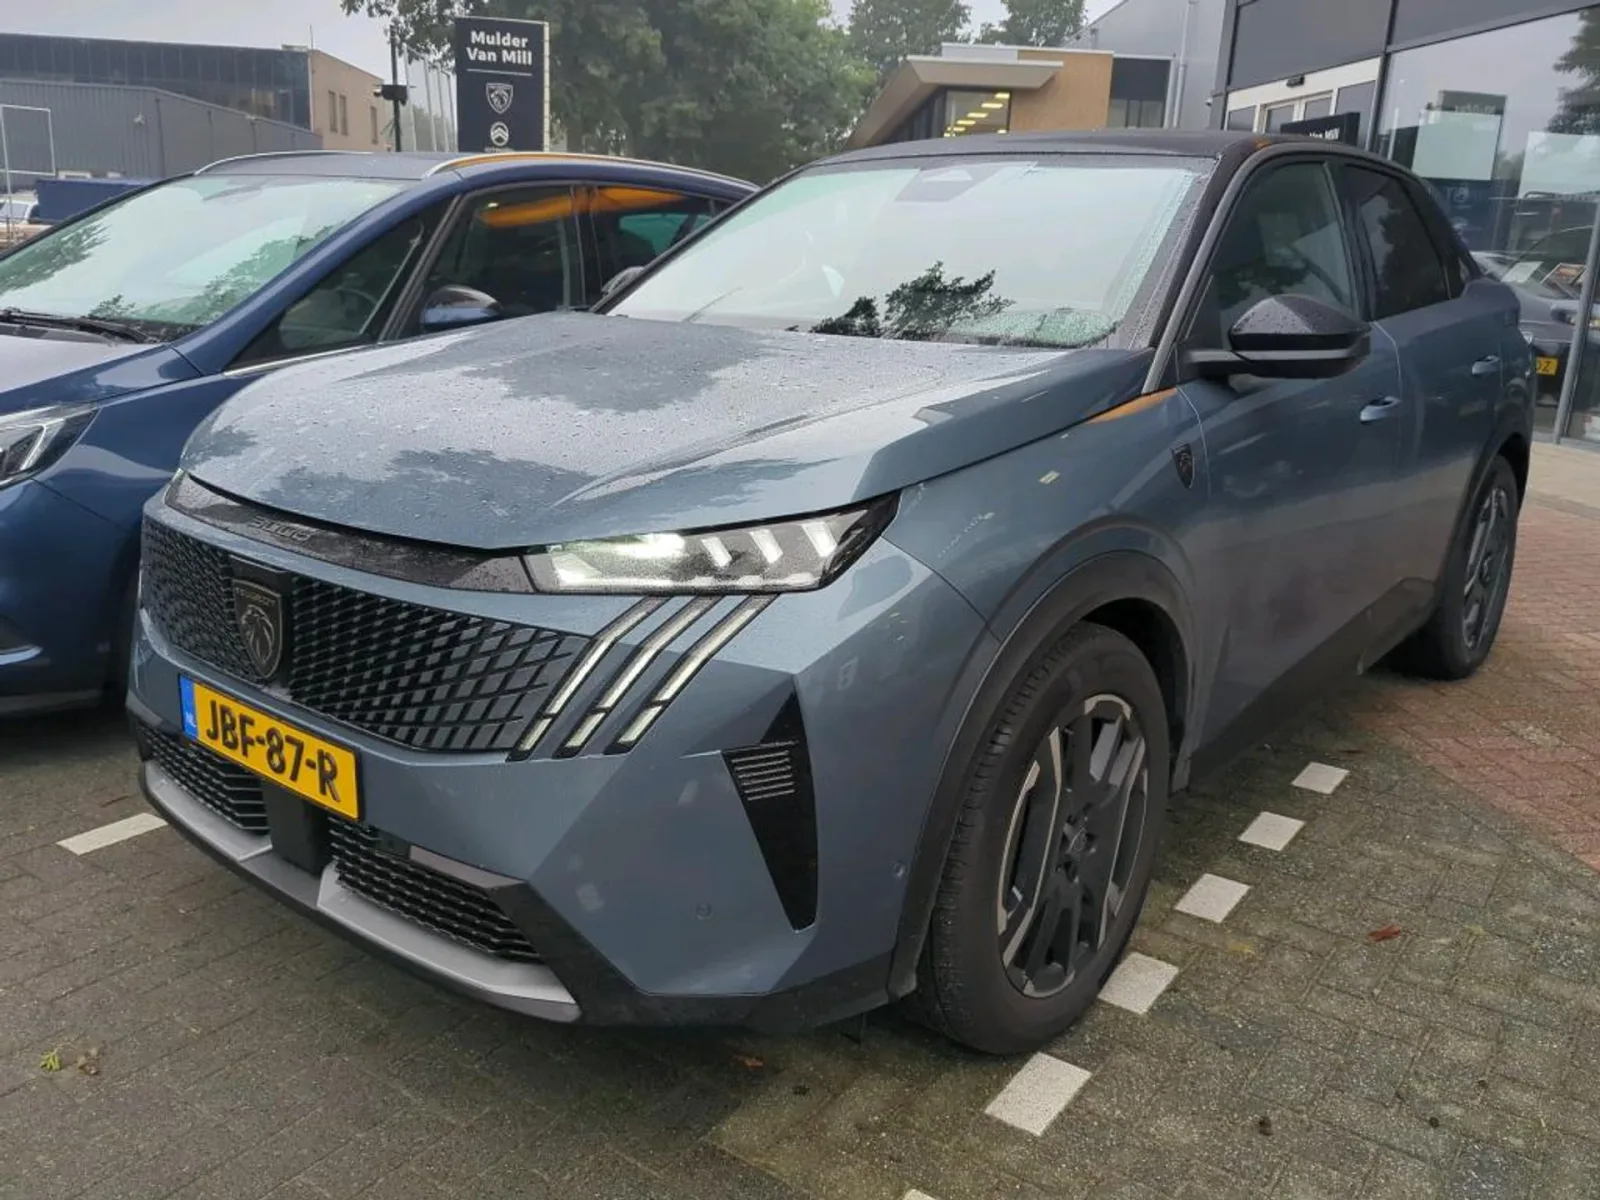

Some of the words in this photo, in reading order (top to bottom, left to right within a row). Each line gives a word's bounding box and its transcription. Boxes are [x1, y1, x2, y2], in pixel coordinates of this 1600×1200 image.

[470, 30, 528, 48] Mulder
[465, 47, 497, 62] Van
[501, 49, 533, 66] Mill
[206, 700, 341, 803] JBF-87-R
